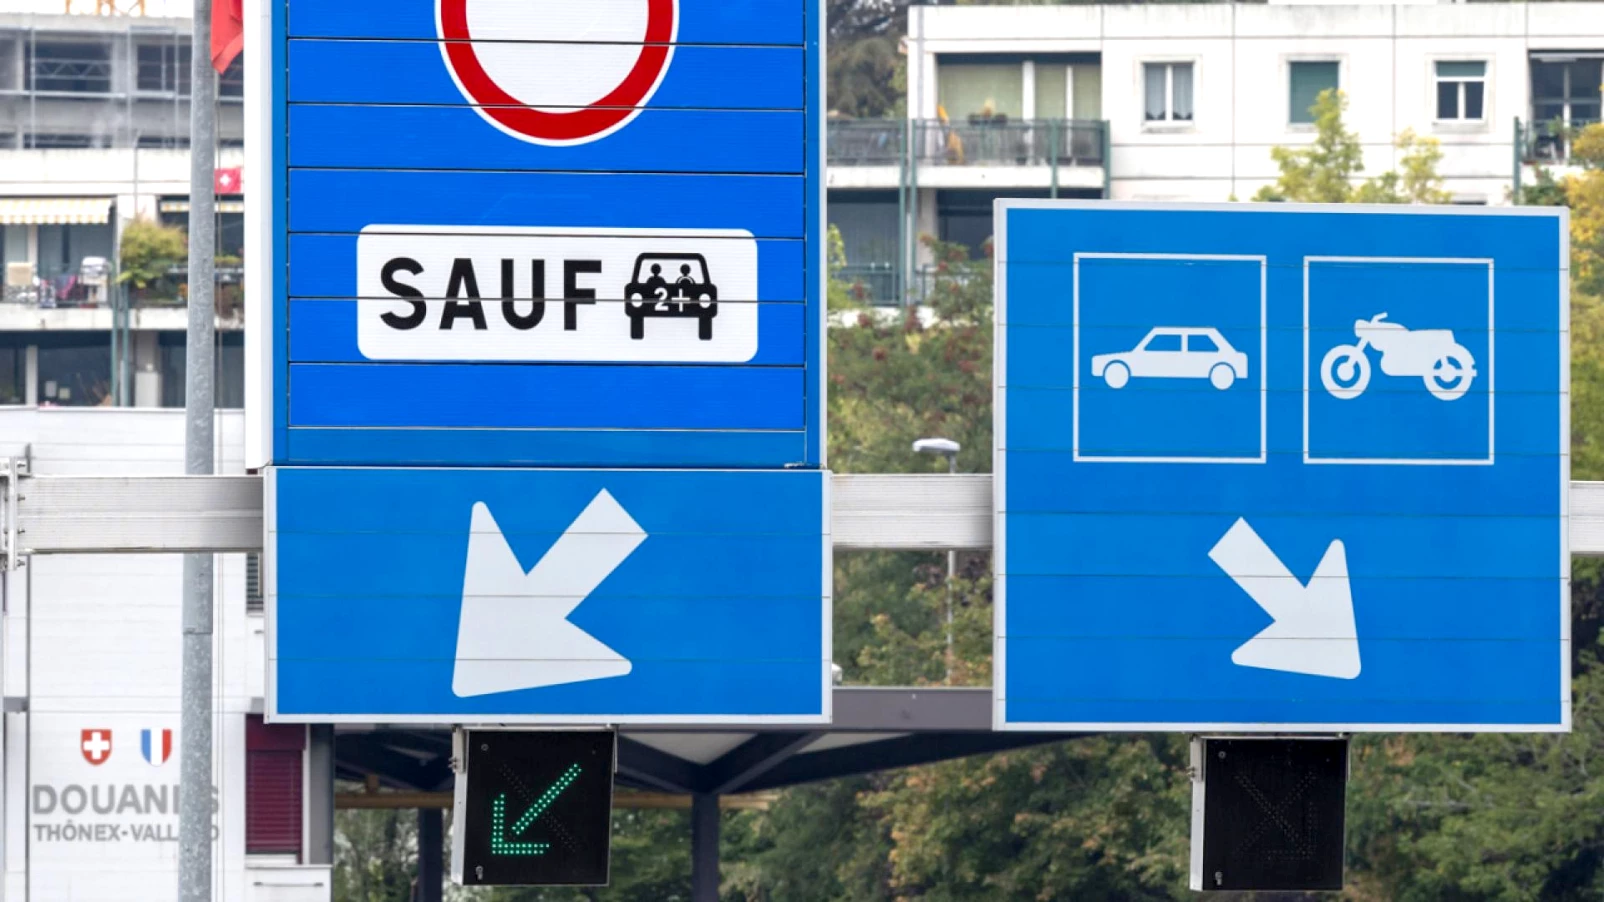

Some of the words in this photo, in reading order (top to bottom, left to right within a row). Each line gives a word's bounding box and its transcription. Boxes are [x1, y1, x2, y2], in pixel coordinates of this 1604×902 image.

[379, 256, 602, 331] SAUF
[653, 287, 691, 312] 2+
[32, 784, 219, 815] DOUAN
[33, 819, 219, 841] THÔNEX-VALL
